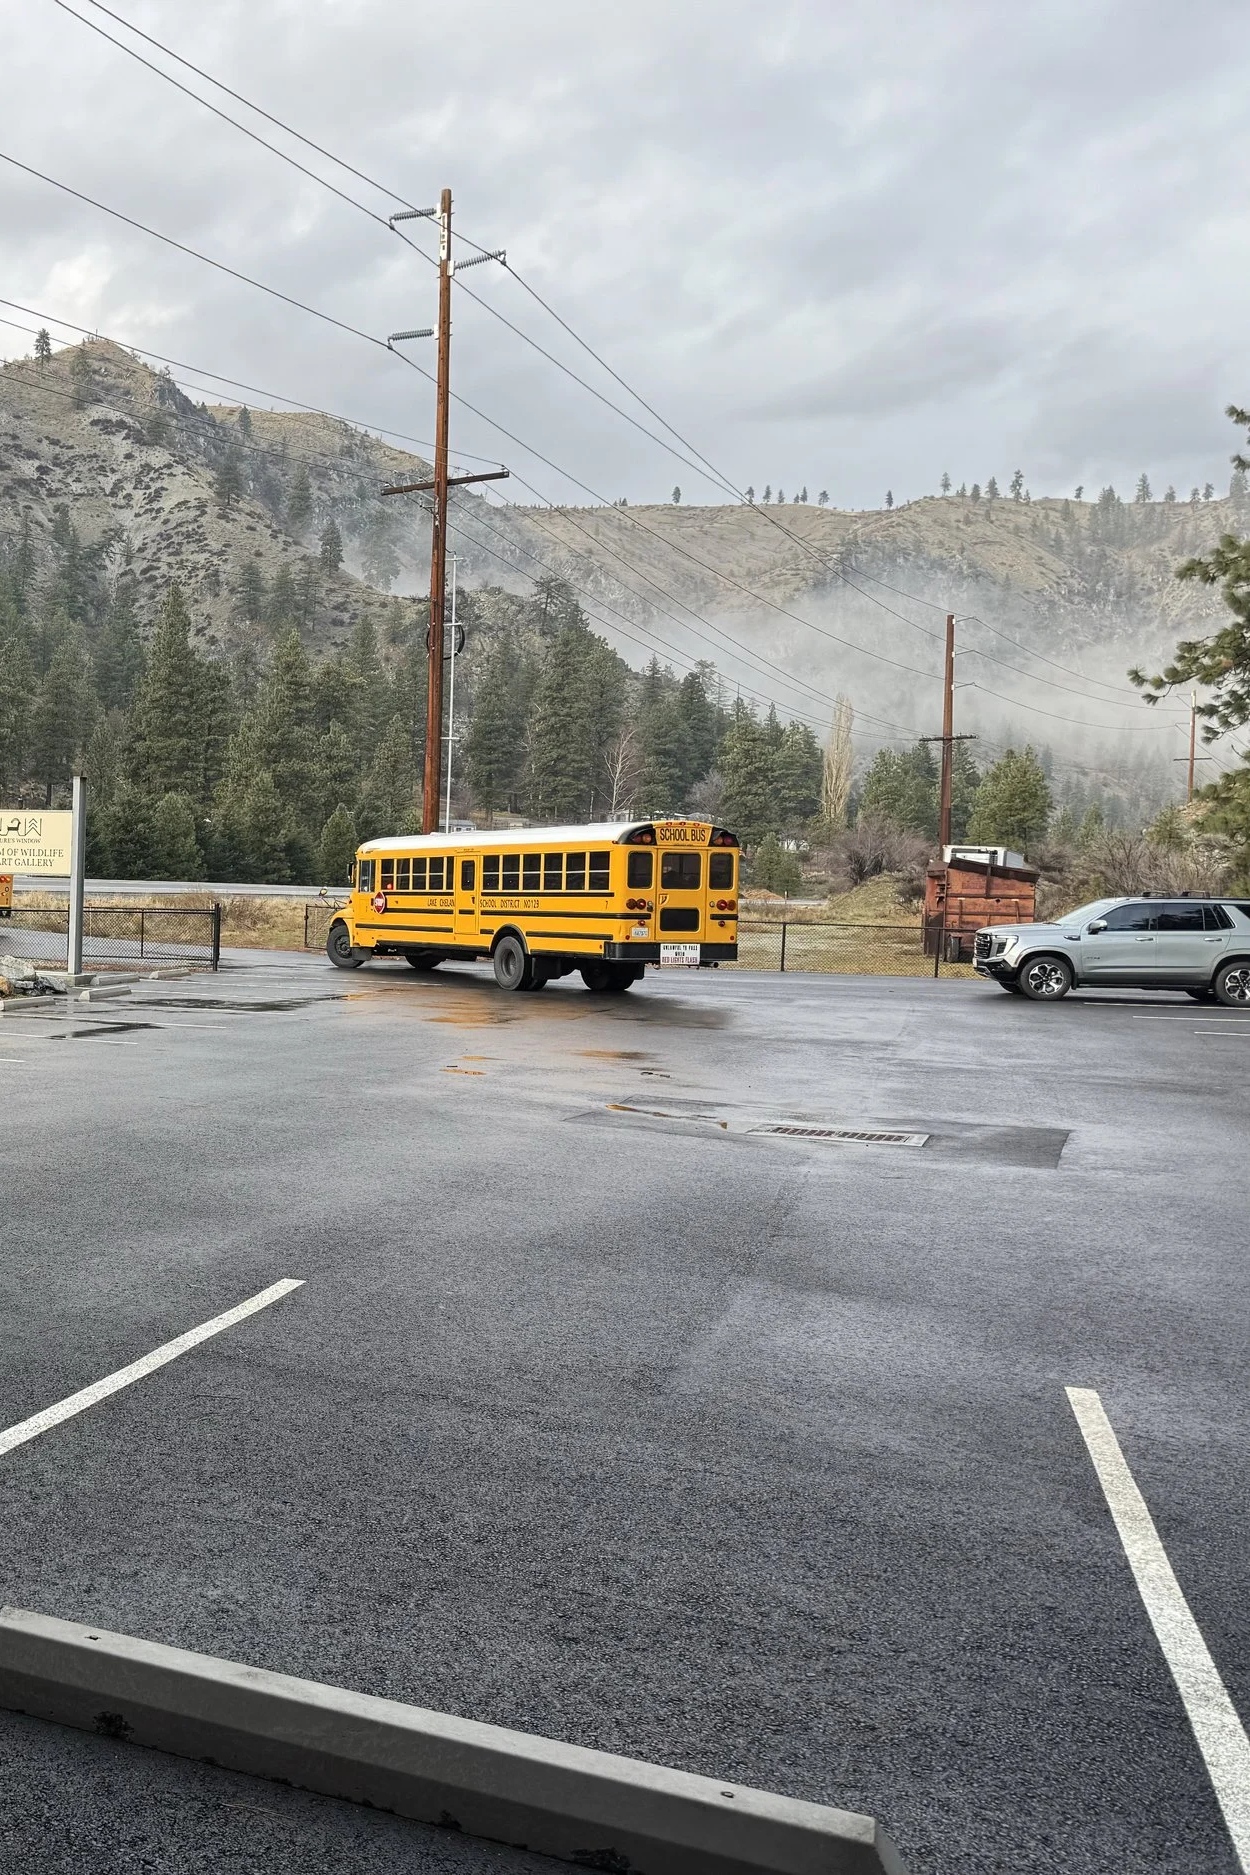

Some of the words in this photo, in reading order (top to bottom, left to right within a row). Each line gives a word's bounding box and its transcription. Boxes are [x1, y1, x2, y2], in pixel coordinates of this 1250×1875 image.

[659, 828, 689, 842] SCHOOL
[691, 829, 706, 842] BUS
[6, 848, 20, 856] OF
[20, 848, 64, 858] WILDLIFE
[14, 858, 55, 867] GALLERY
[427, 898, 437, 906] LAKE
[439, 898, 455, 907] CHELAN
[479, 899, 497, 908] SCHOOL
[500, 899, 520, 908] DISTRICT
